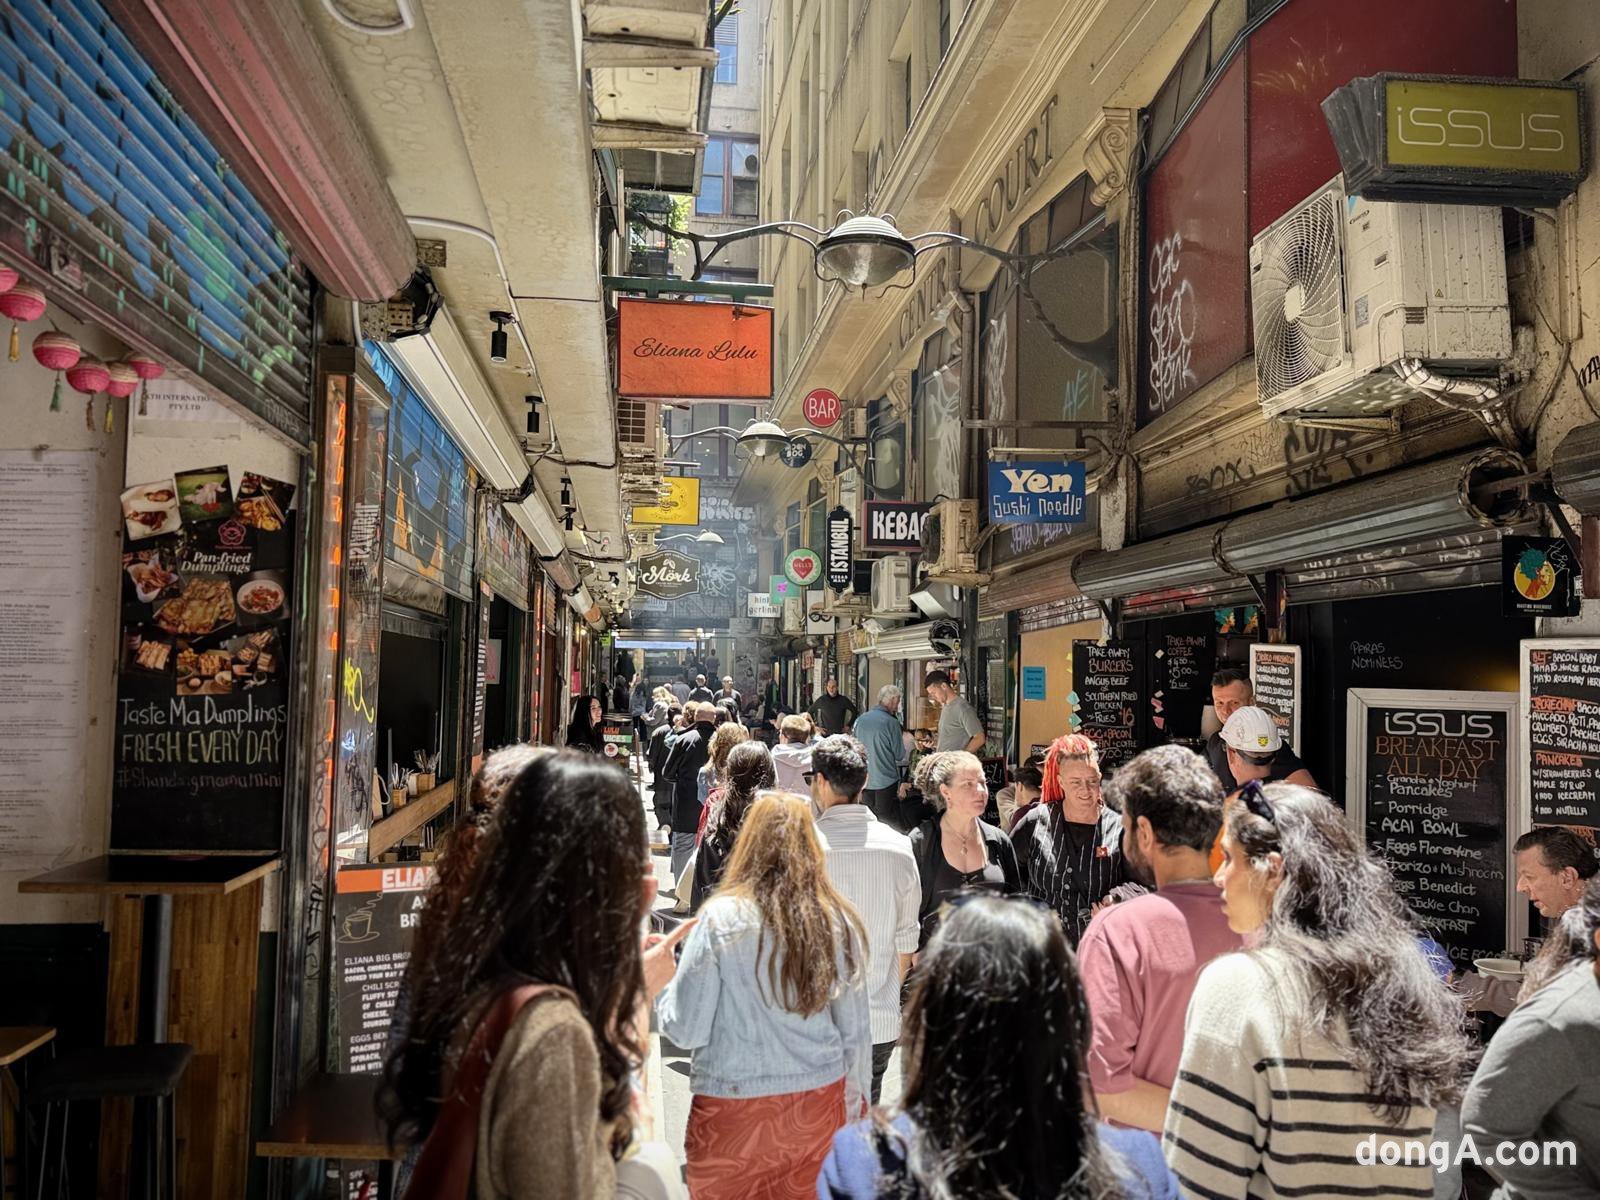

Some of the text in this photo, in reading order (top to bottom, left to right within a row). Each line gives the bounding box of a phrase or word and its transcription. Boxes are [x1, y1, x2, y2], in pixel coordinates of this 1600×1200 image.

[974, 94, 1058, 247] COURT
[634, 338, 758, 361] Eliana Lulu
[808, 397, 836, 418] BAR
[1000, 468, 1073, 494] Yen
[993, 494, 1030, 518] Sushi
[830, 518, 849, 572] ISTANBUL
[181, 560, 251, 575] Dumplings
[193, 552, 252, 565] Pan-fried
[1087, 647, 1130, 659] TAKE AWAY
[1088, 659, 1134, 673] BURGERS
[1085, 676, 1130, 687] ANGUS BEEF
[119, 693, 287, 736] Taste Ma Dumplings
[1094, 702, 1122, 711] CHICKEN
[120, 729, 284, 765] FRESH EVERY DAY
[1375, 735, 1500, 760] BREAKFAST
[1386, 756, 1487, 779] ALL DAY
[1388, 781, 1453, 797] Pancakes
[1533, 780, 1585, 790] MAPLE SYRUP
[1388, 801, 1449, 820] Porridge
[1381, 817, 1470, 838] ACAI BOWL
[1440, 861, 1505, 881] Mushroom
[1419, 877, 1478, 897] Benedict
[344, 956, 374, 966] ELIANA
